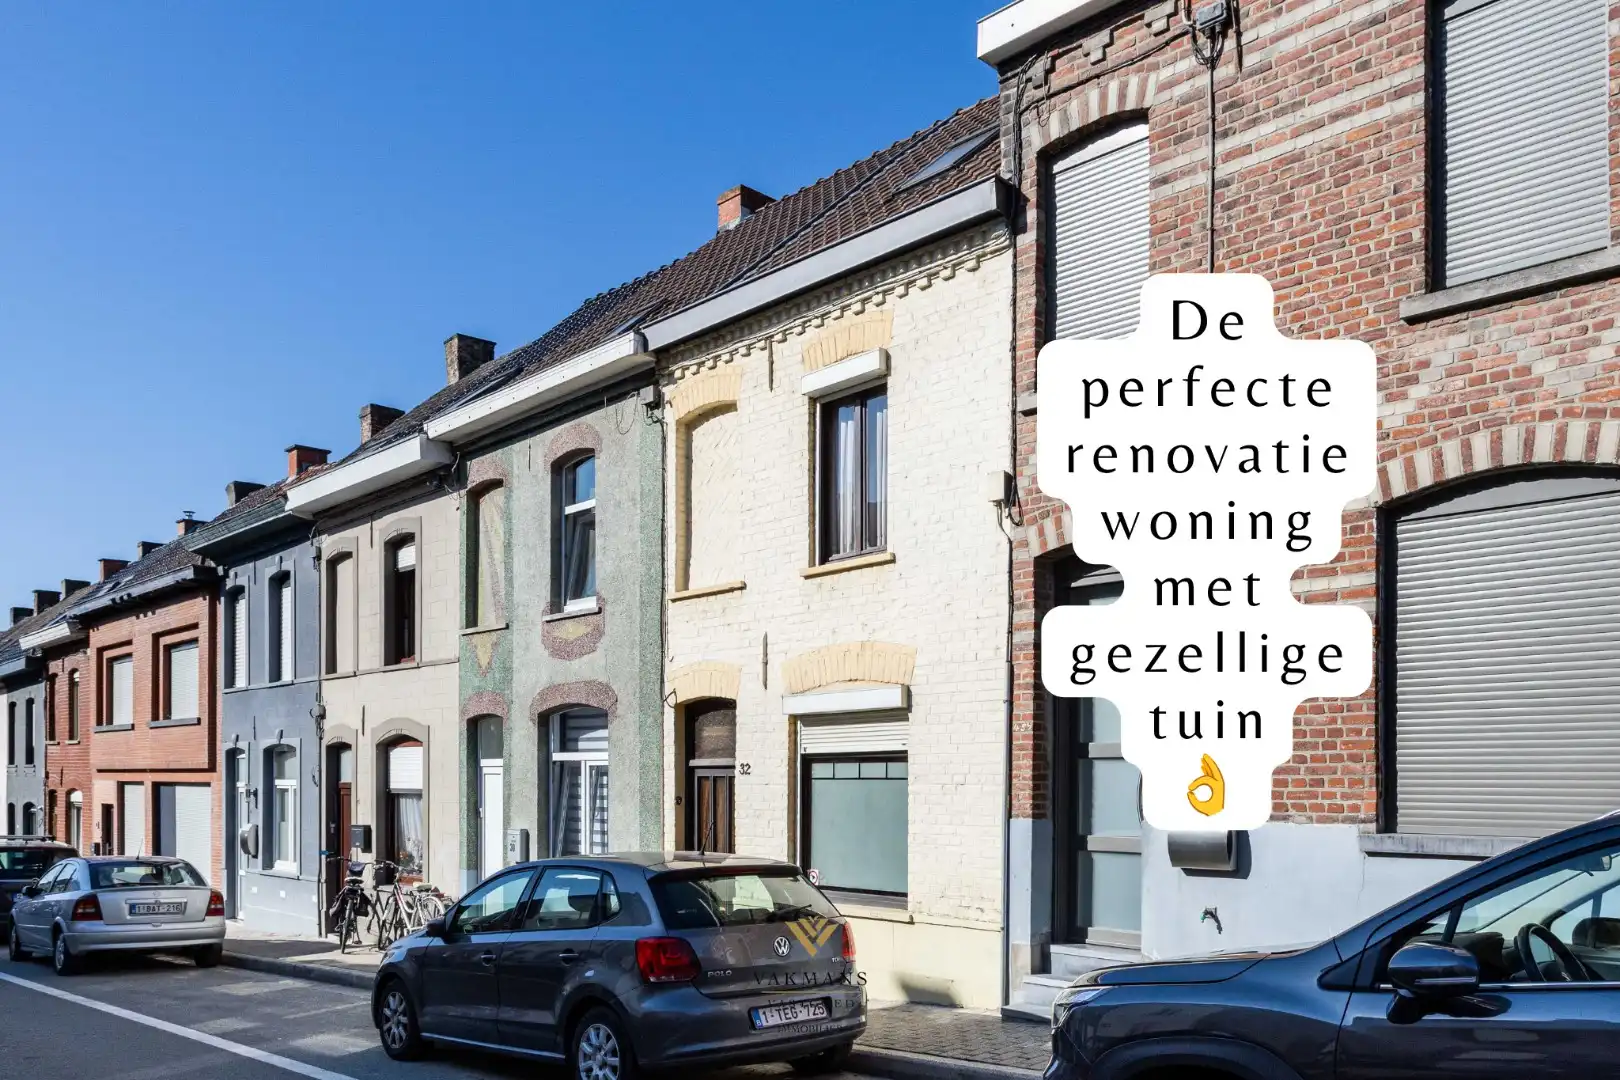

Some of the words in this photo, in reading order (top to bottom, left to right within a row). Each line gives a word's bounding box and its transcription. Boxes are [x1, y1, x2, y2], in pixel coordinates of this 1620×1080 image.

[739, 762, 751, 775] 32
[707, 969, 732, 978] POLO
[762, 1003, 826, 1023] 1-TEG-725
